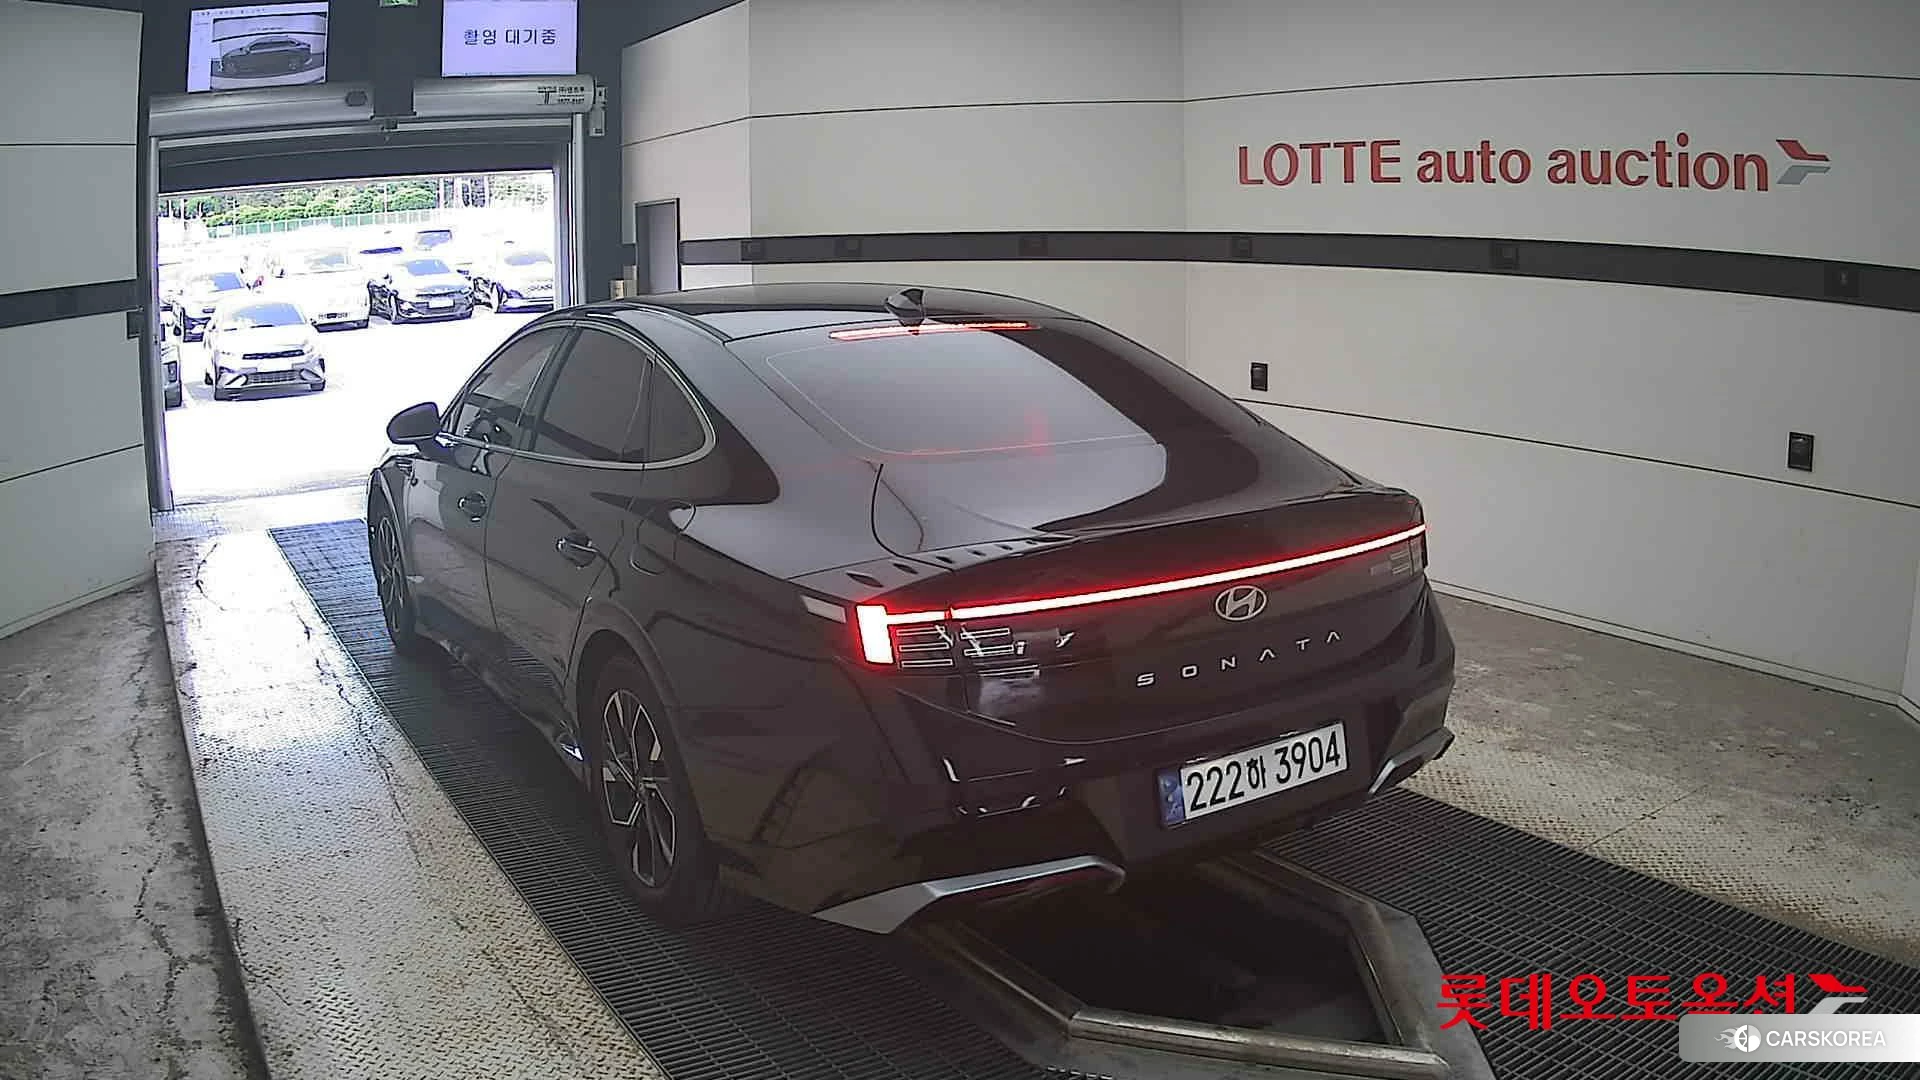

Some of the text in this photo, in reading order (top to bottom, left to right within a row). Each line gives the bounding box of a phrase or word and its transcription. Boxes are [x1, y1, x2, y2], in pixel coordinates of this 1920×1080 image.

[464, 28, 556, 46] 촬영 대기중
[1239, 132, 1769, 192] LOTTE auto auction
[1136, 631, 1341, 687] SONATA
[1186, 730, 1341, 812] 222하 3904
